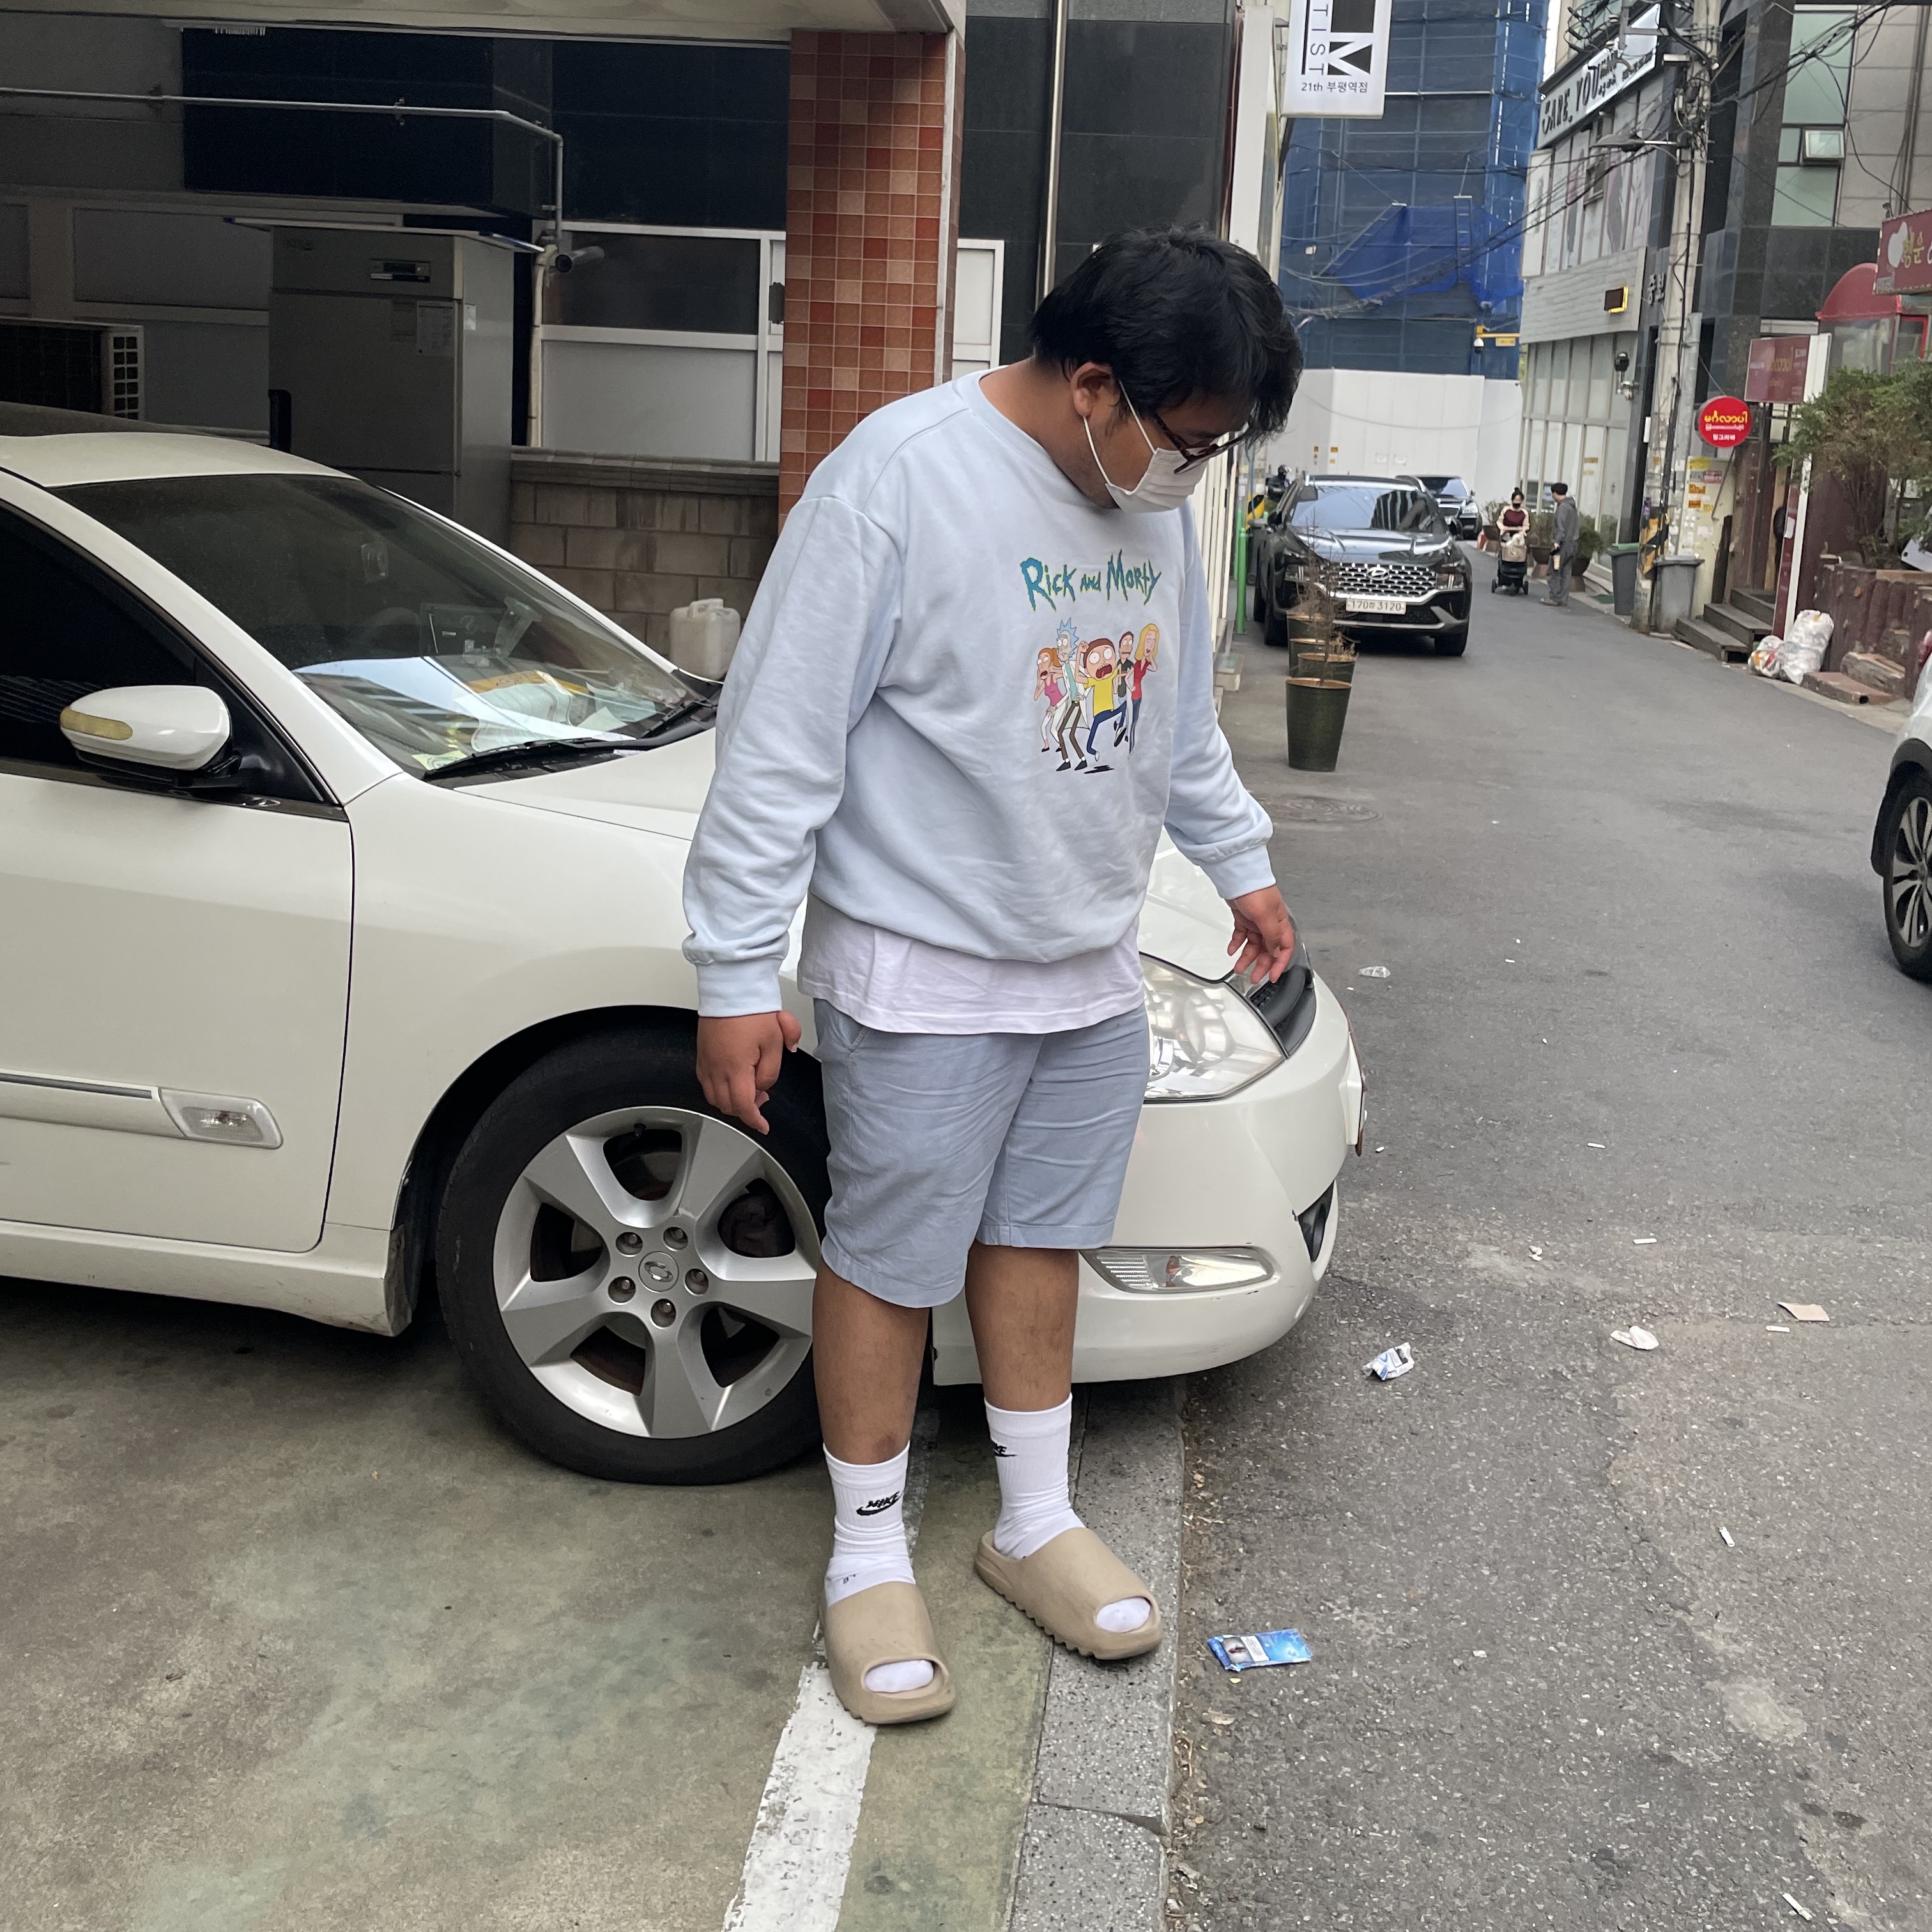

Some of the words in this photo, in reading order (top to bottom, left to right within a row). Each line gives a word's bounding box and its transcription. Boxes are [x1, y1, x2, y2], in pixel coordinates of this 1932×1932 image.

[1301, 82, 1322, 91] 21th
[1326, 81, 1368, 93] 부평역점
[1020, 557, 1077, 611] Rick
[1377, 601, 1401, 611] 3120
[865, 1491, 900, 1508] NIKE
